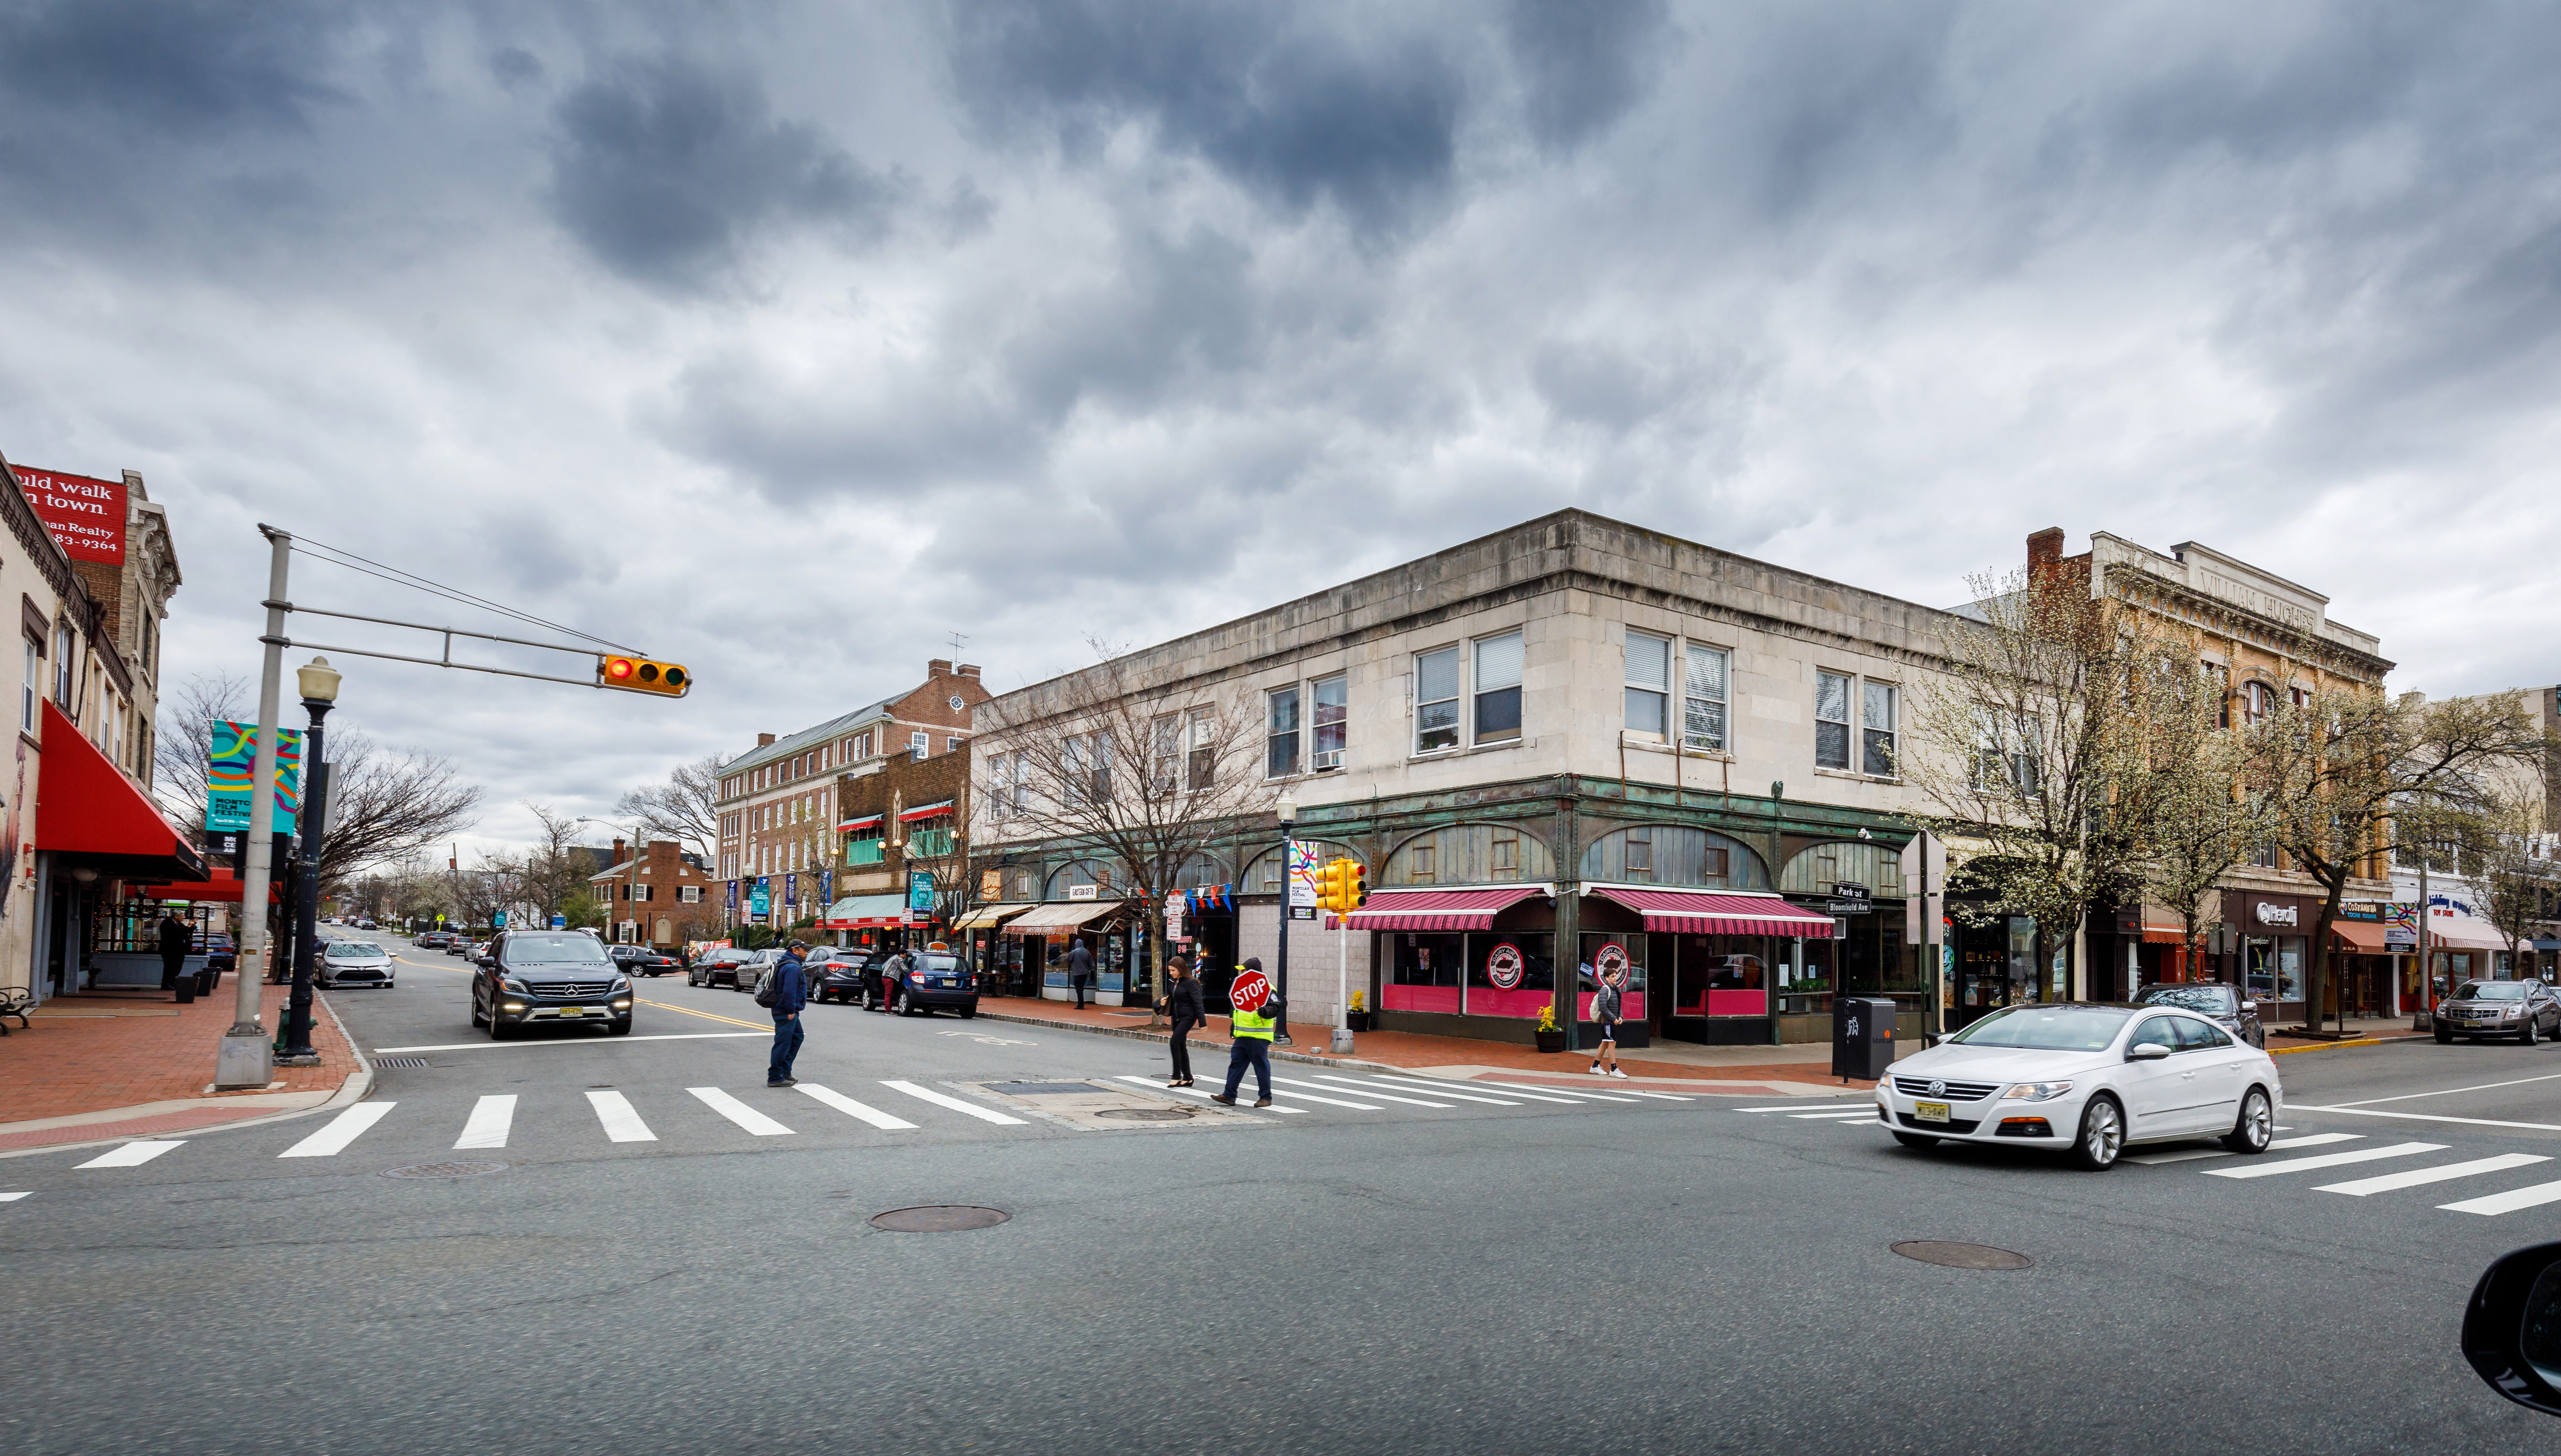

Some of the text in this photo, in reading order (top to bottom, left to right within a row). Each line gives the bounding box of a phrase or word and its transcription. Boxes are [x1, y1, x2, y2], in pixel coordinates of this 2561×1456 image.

[58, 482, 113, 500] walk
[44, 493, 107, 515] town.
[68, 523, 115, 539] Realty
[53, 534, 117, 552] 83-9364
[2201, 571, 2314, 631] WILLIAM HUGHES
[1839, 887, 1853, 896] Park
[2348, 902, 2377, 913] COSTANERA
[1493, 949, 1505, 962] DAIRY
[1600, 948, 1622, 961] DAIRY AIR
[1234, 978, 1266, 1005] STOP
